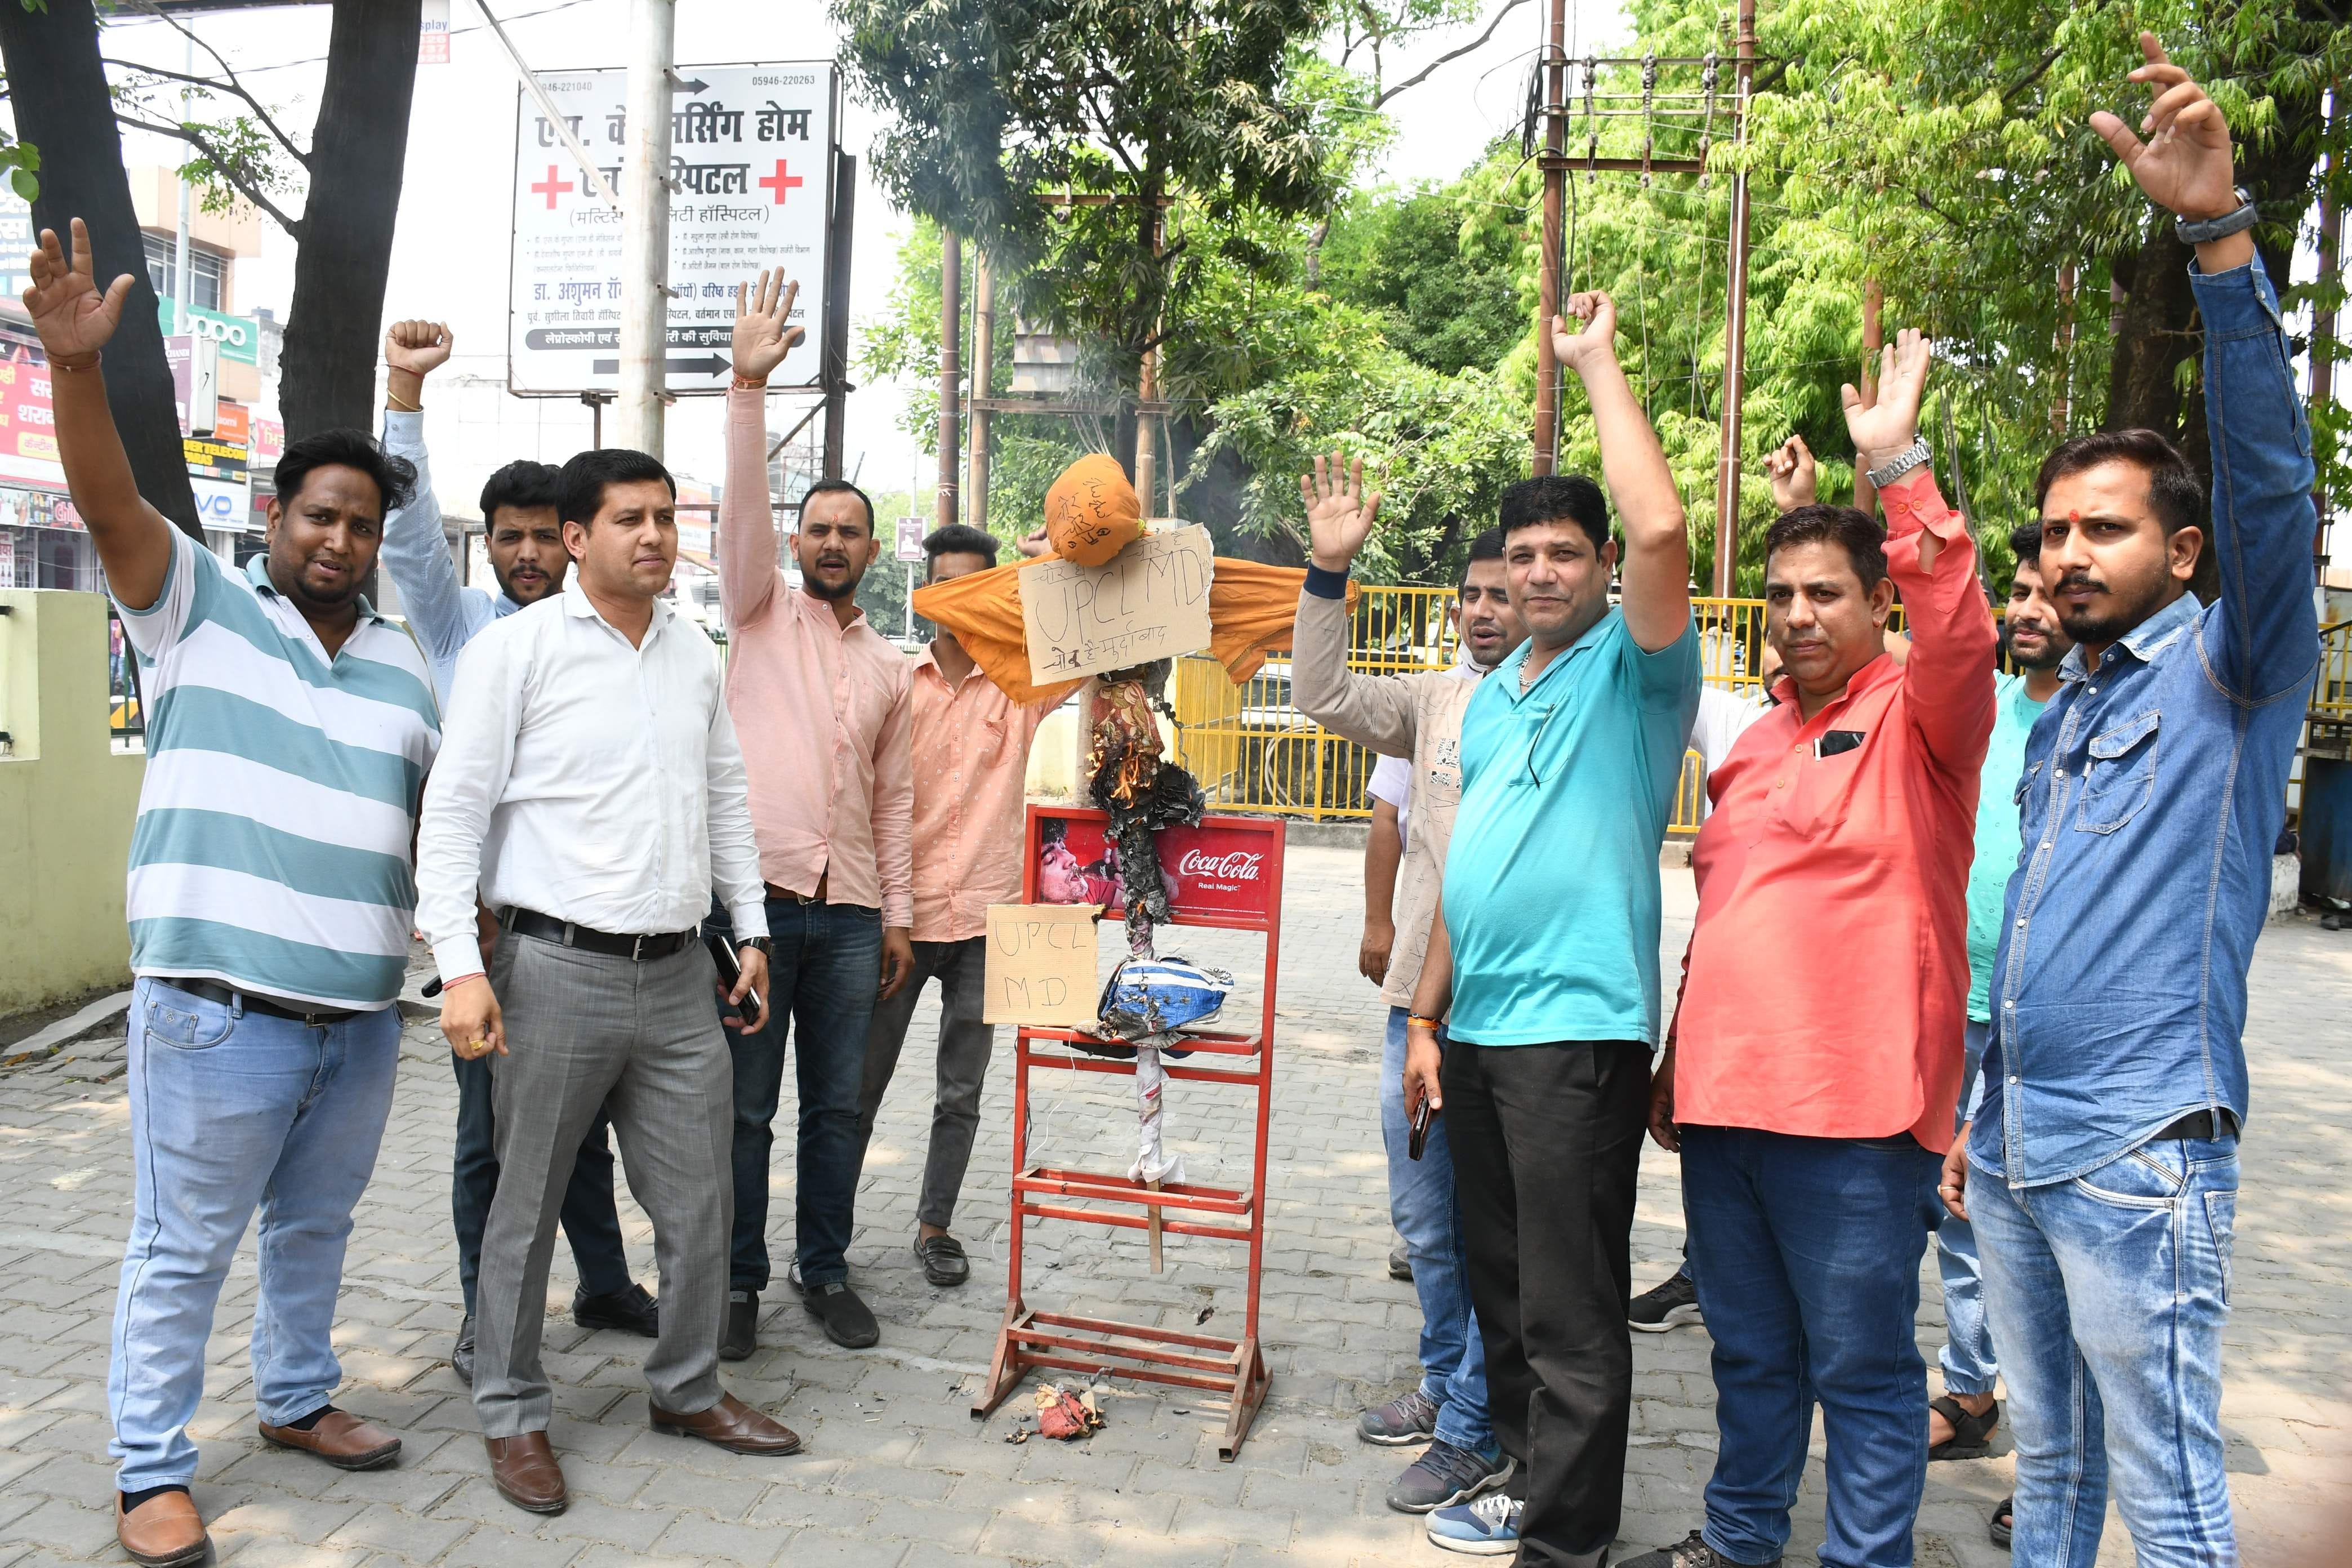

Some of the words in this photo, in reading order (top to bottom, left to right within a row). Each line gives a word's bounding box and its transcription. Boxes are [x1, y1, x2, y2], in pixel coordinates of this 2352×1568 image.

[541, 81, 592, 92] 946-221040
[752, 75, 816, 86] 05946-220263
[755, 100, 812, 141] होम
[558, 277, 602, 306] अंशुमन
[598, 309, 621, 320] हॉस्पिट
[696, 307, 720, 319] वर्तमान
[598, 332, 613, 344] एवं
[681, 329, 697, 342] की
[1035, 564, 1134, 644] UPCL
[1146, 549, 1203, 607] MD
[1179, 848, 1265, 881] Coca-Cola
[995, 920, 1087, 956] UPCL
[1004, 977, 1067, 1009] MD
